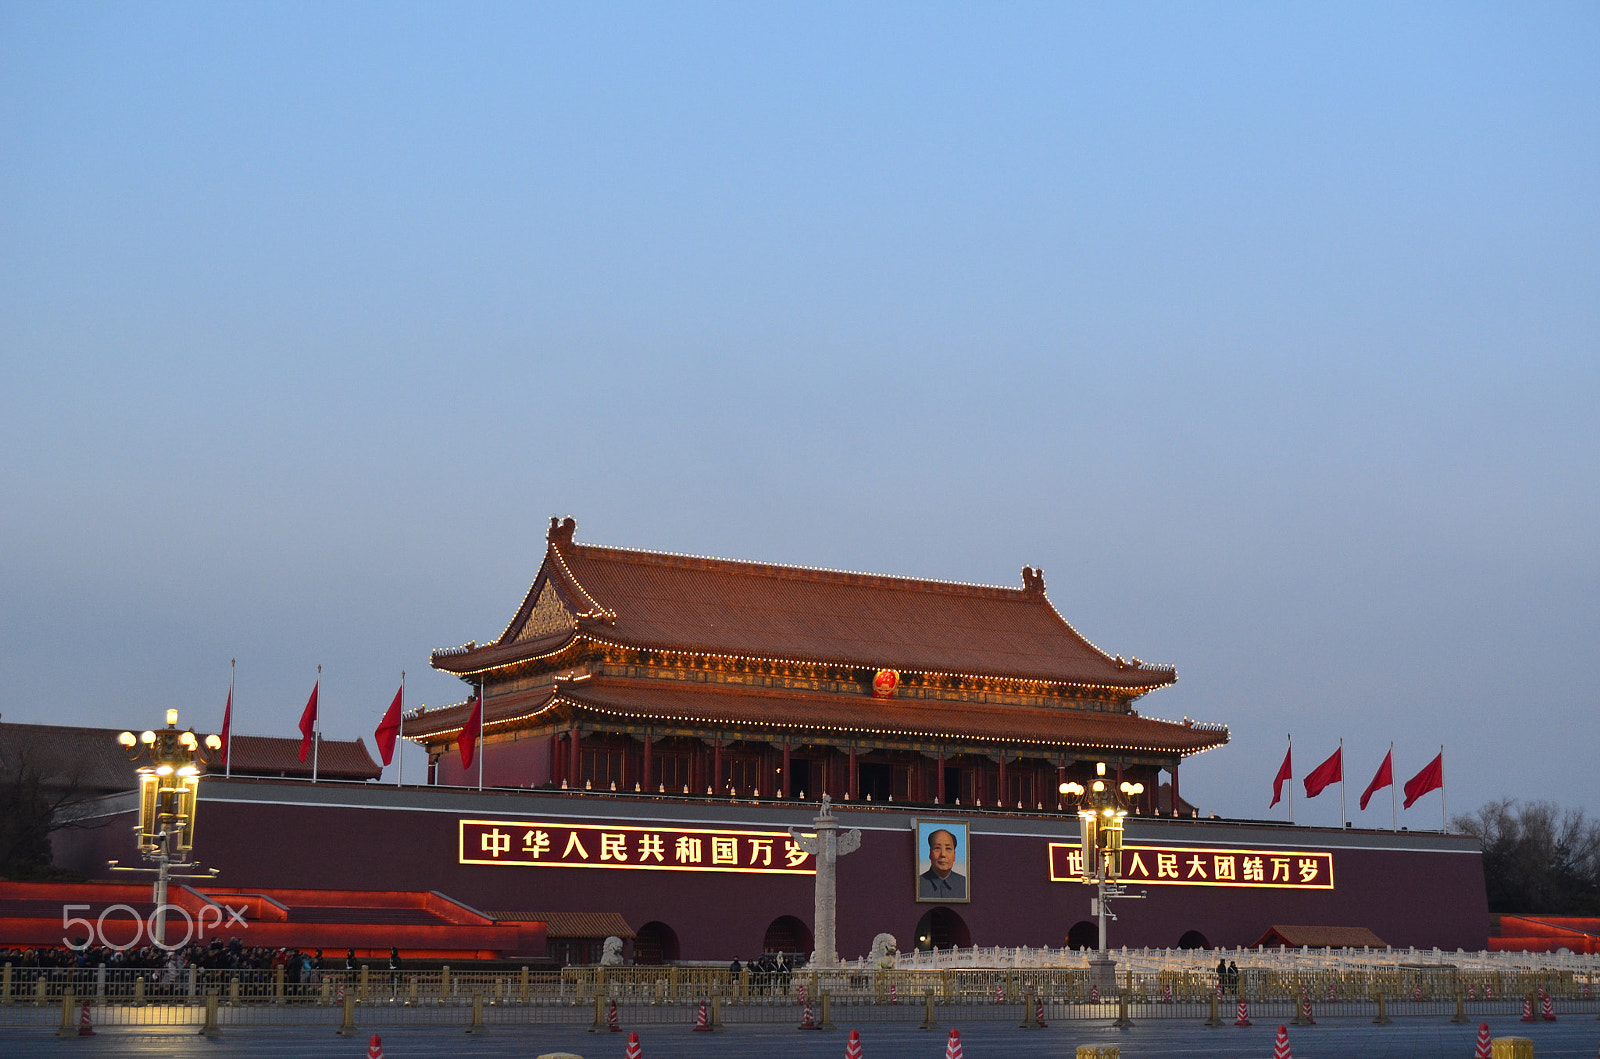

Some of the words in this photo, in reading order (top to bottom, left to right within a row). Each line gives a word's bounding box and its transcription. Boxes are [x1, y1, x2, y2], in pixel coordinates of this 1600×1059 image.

[481, 828, 810, 867] 中华人民共和国万岁
[1066, 850, 1319, 882] 世人民大团结万岁
